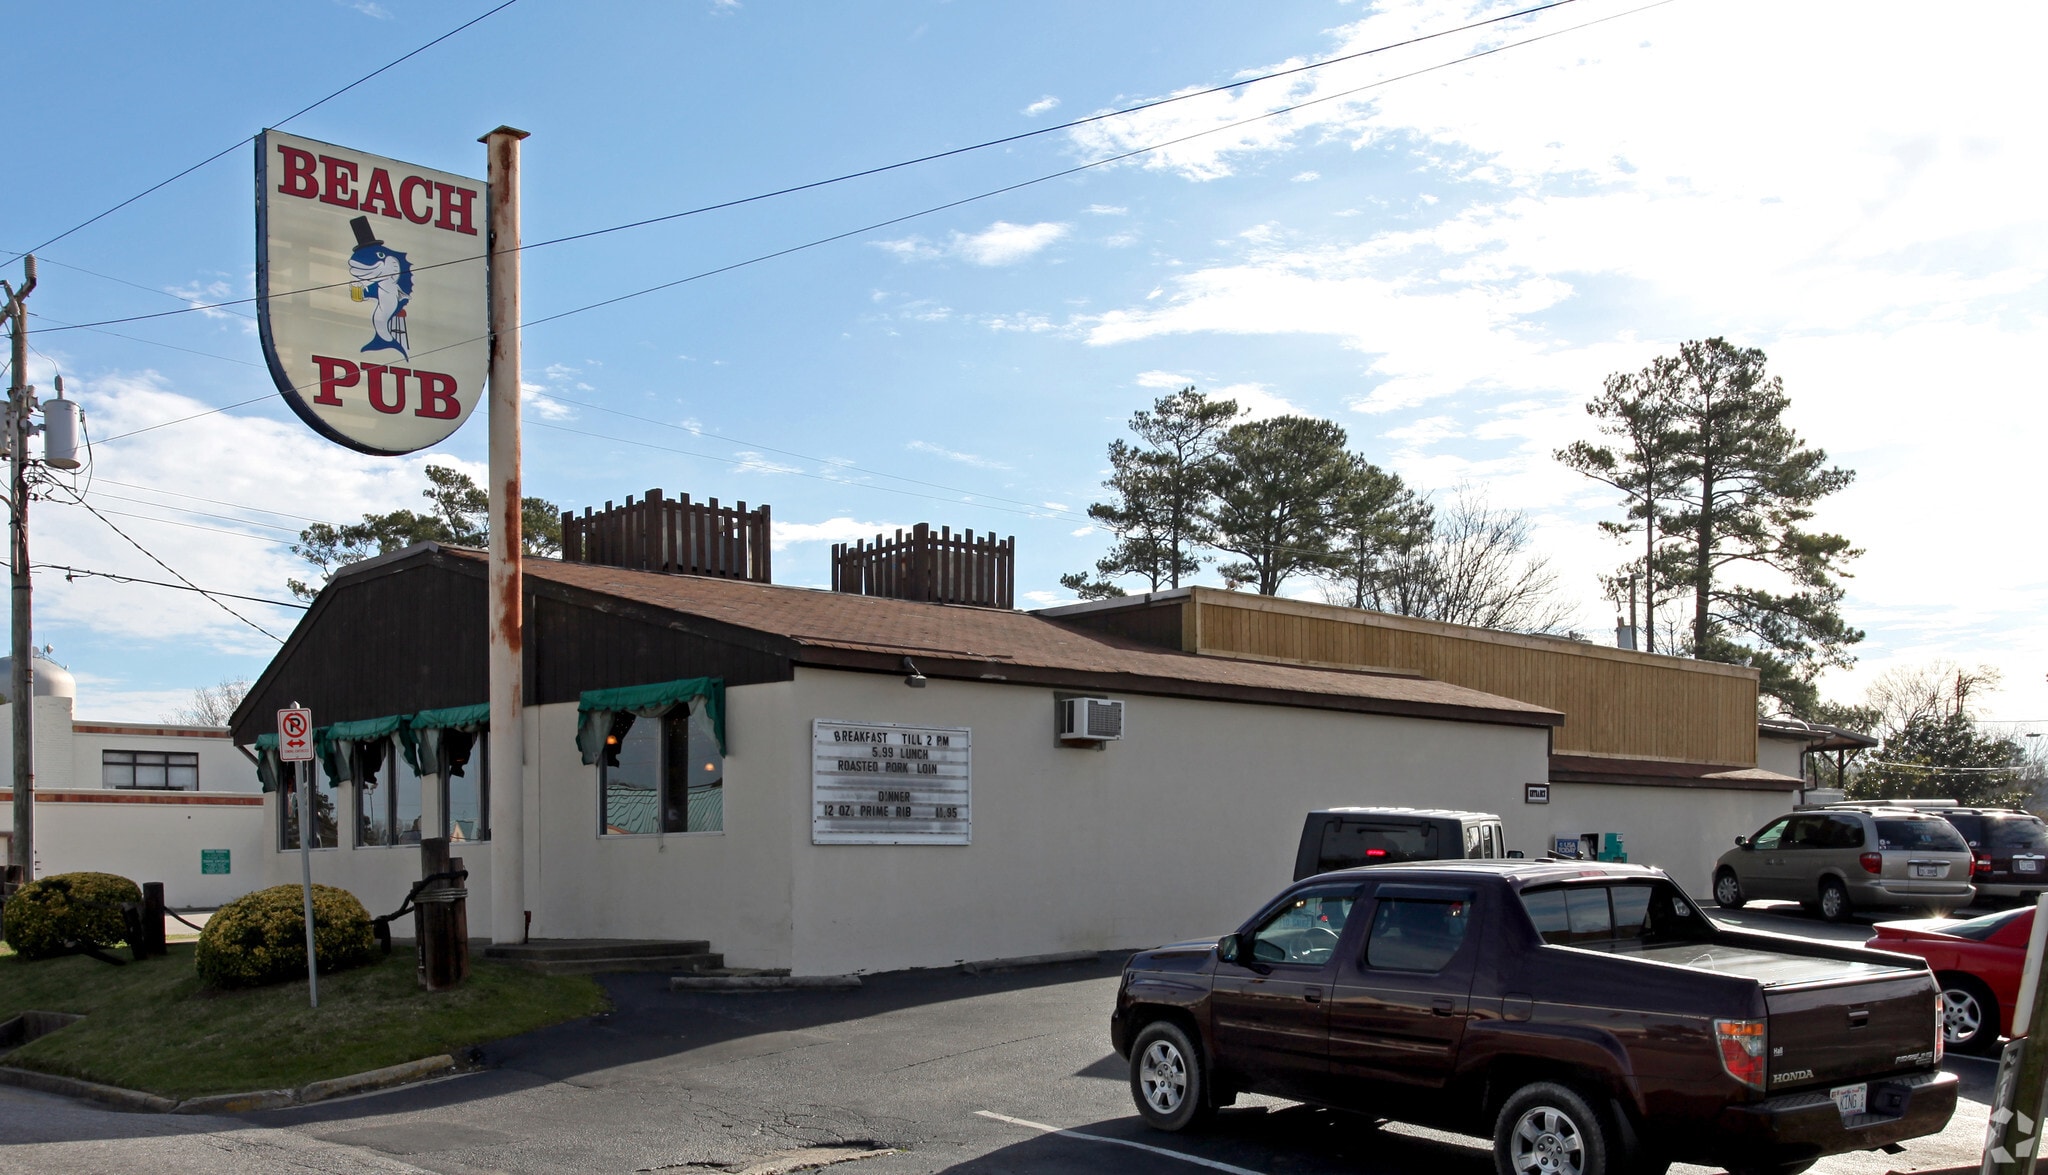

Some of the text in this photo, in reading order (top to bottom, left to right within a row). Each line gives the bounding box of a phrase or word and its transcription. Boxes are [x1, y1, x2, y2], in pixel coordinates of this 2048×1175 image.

[277, 144, 478, 236] BEACH
[312, 354, 461, 420] PUB
[834, 730, 949, 746] BREAKFAST TILL 2 PM
[872, 746, 928, 760] 5.99 LUNCH
[838, 760, 937, 774] ROASTED PORK LOIN
[878, 791, 910, 803] DINNER
[824, 804, 834, 816] 12
[860, 805, 889, 817] PRIME
[896, 806, 911, 817] RIB
[1773, 1069, 1815, 1084] HONDA
[1840, 1093, 1857, 1110] KING
